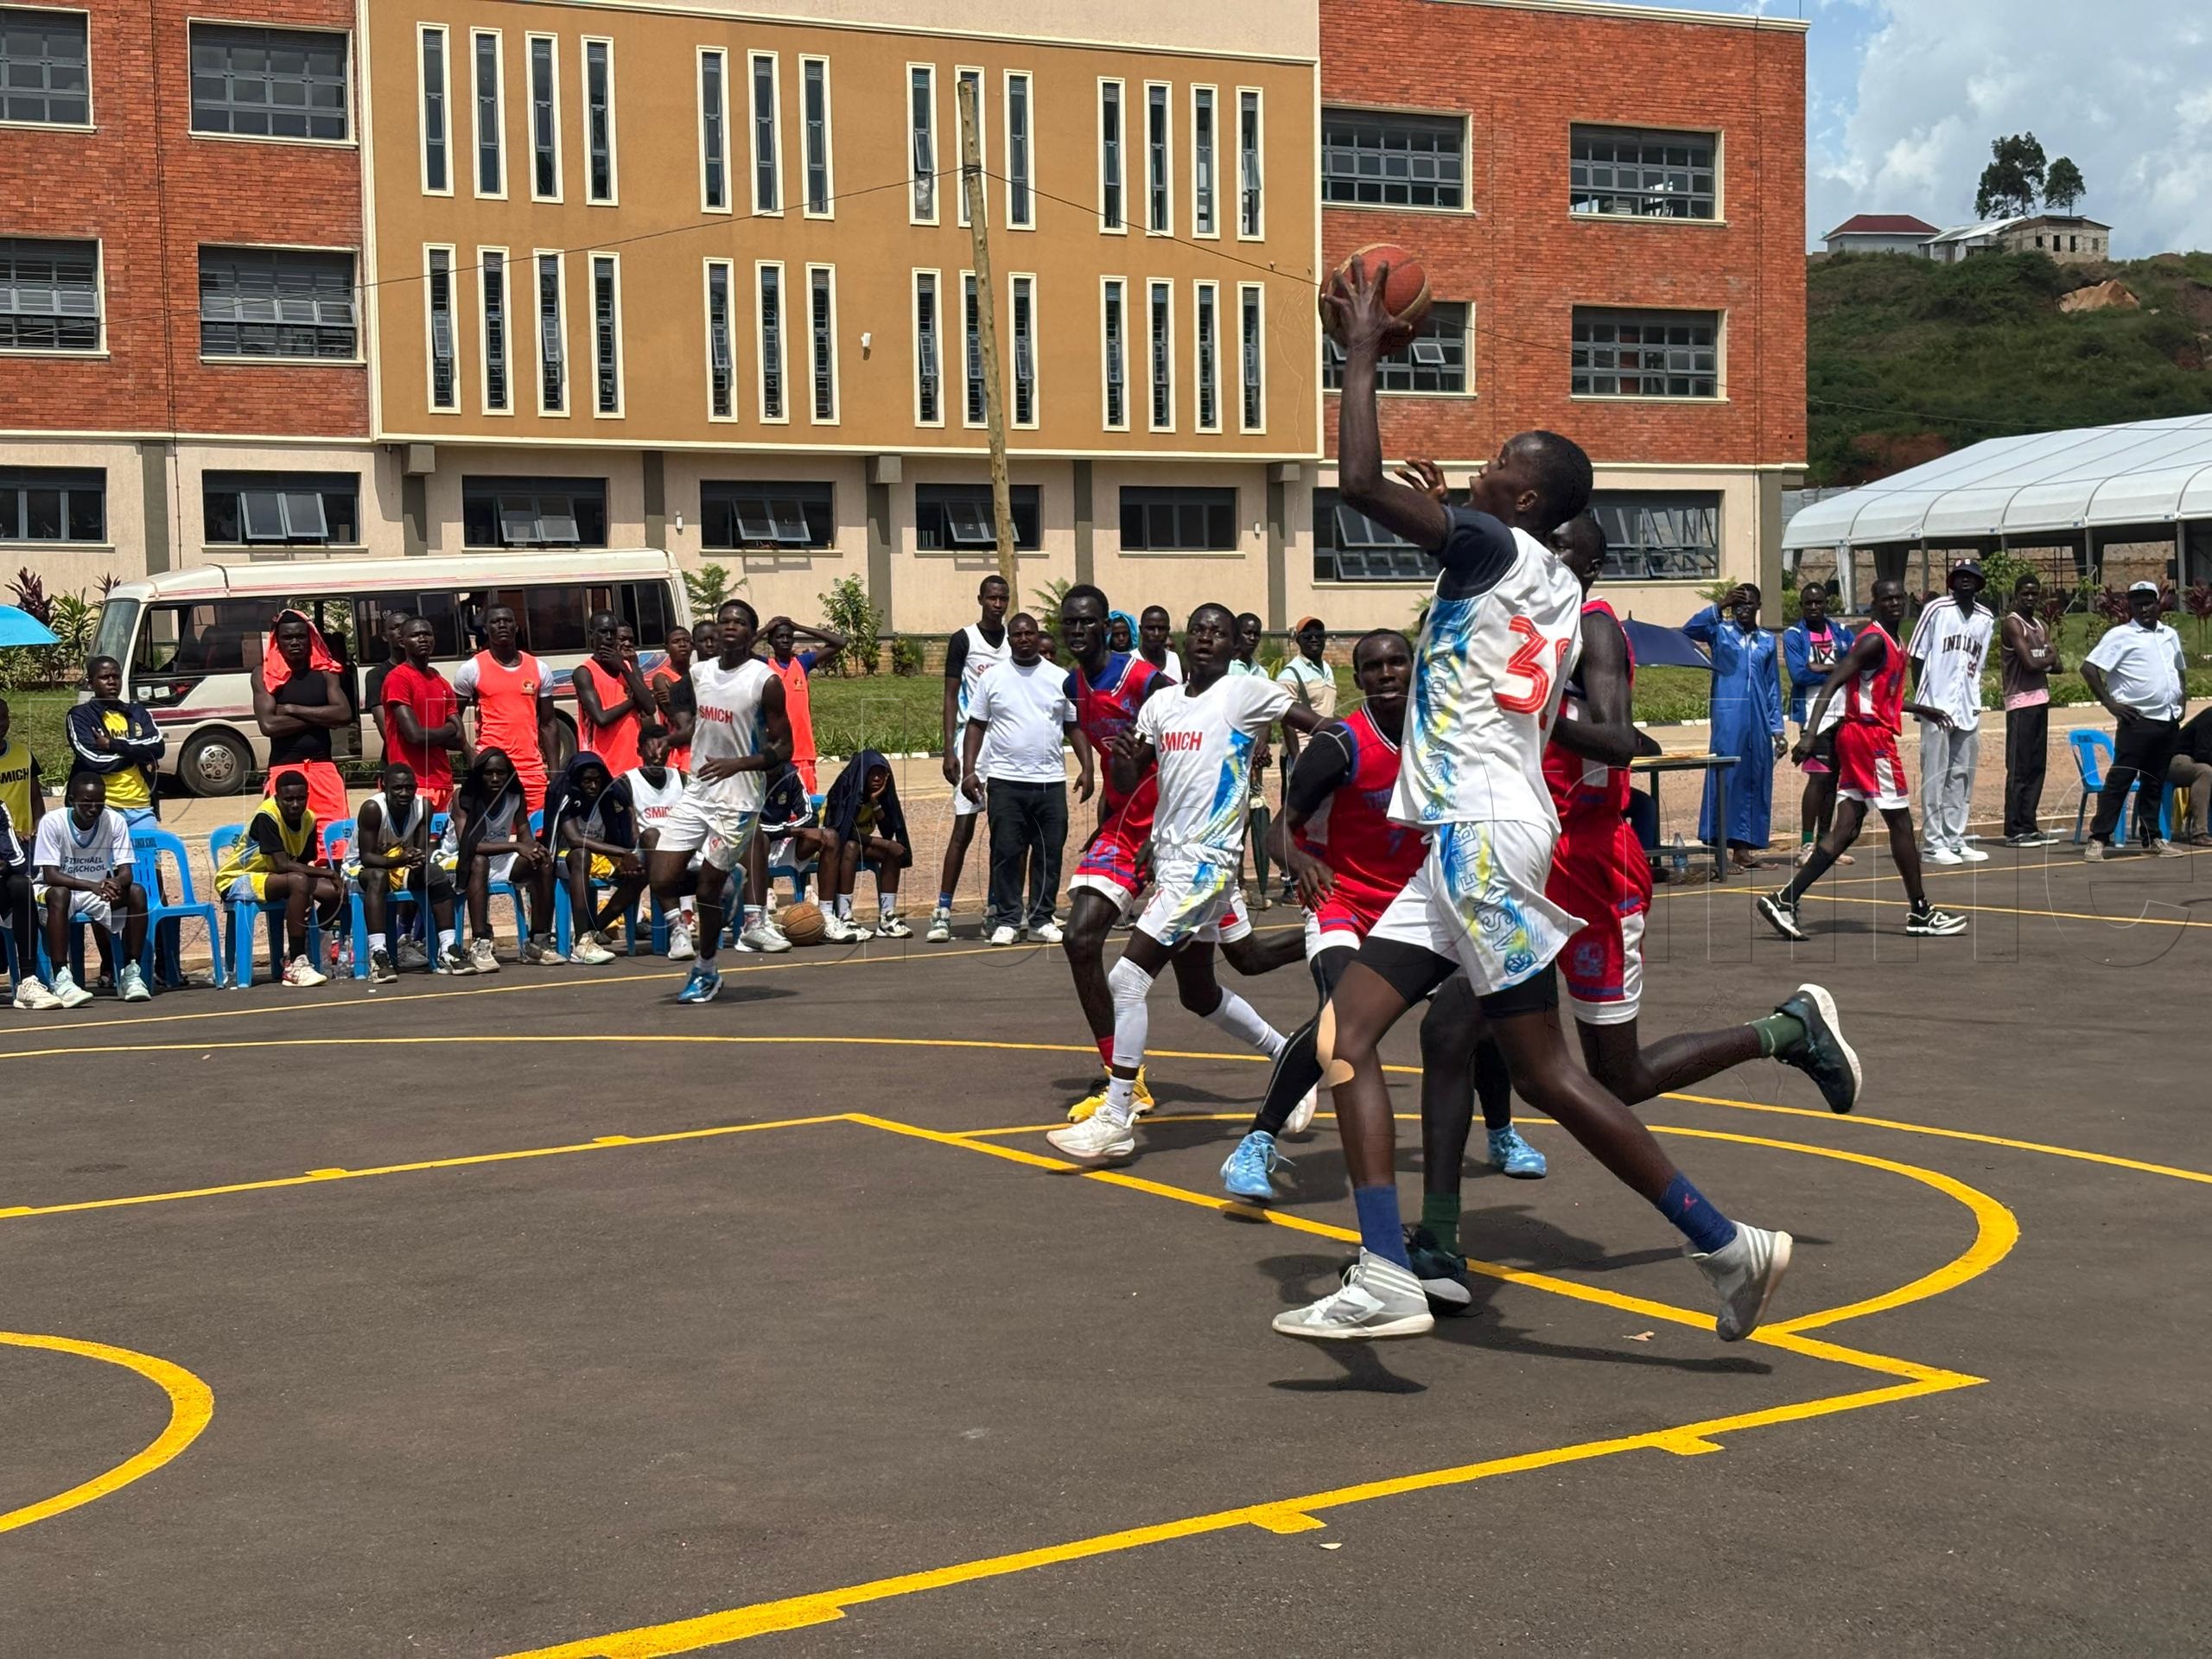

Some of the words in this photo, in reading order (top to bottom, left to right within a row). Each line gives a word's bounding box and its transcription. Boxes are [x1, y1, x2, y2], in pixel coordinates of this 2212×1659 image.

[698, 705, 734, 724] SMICH
[1159, 730, 1204, 753] SMICH
[644, 805, 673, 819] SMIC
